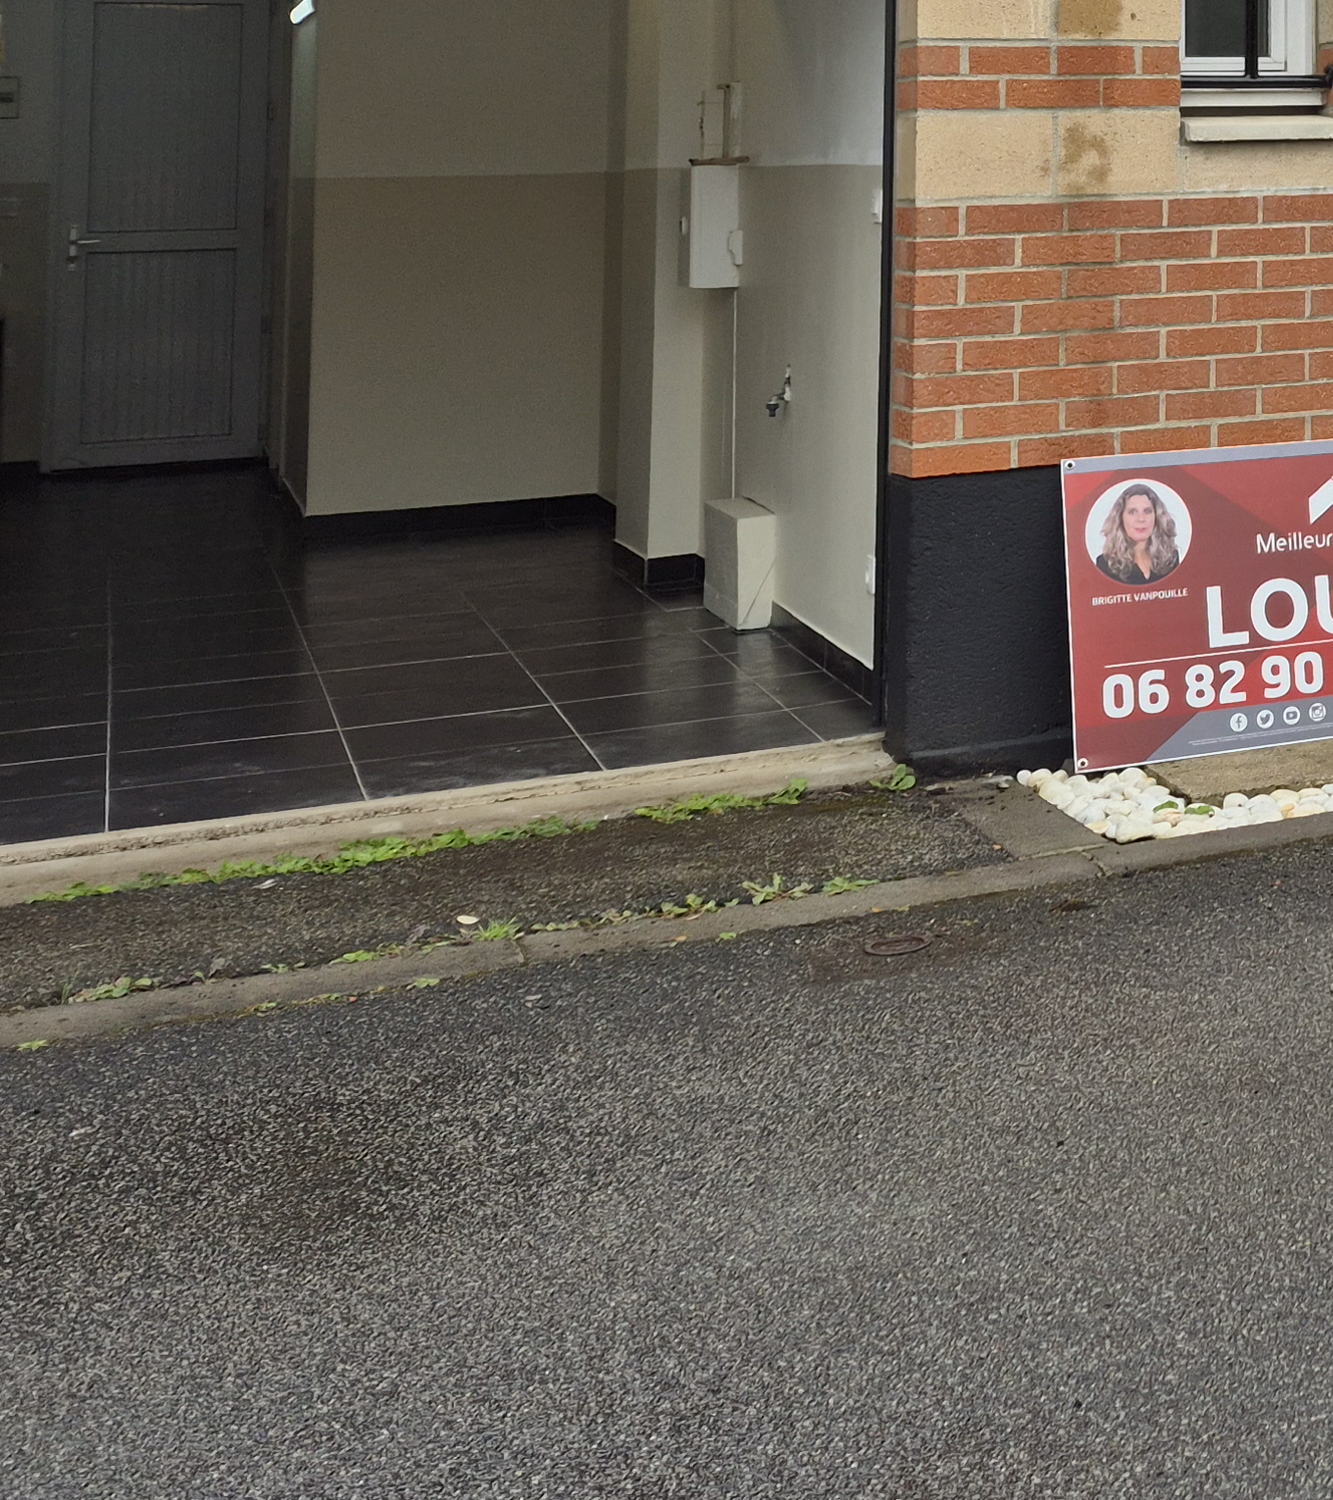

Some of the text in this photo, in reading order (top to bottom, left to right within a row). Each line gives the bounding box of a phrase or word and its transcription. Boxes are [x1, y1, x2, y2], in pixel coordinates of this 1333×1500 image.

[1092, 588, 1188, 606] BRIGITTE VANPOUILLE
[1103, 669, 1170, 719] 06
[1185, 660, 1247, 708] 82
[1261, 651, 1323, 699] 90
